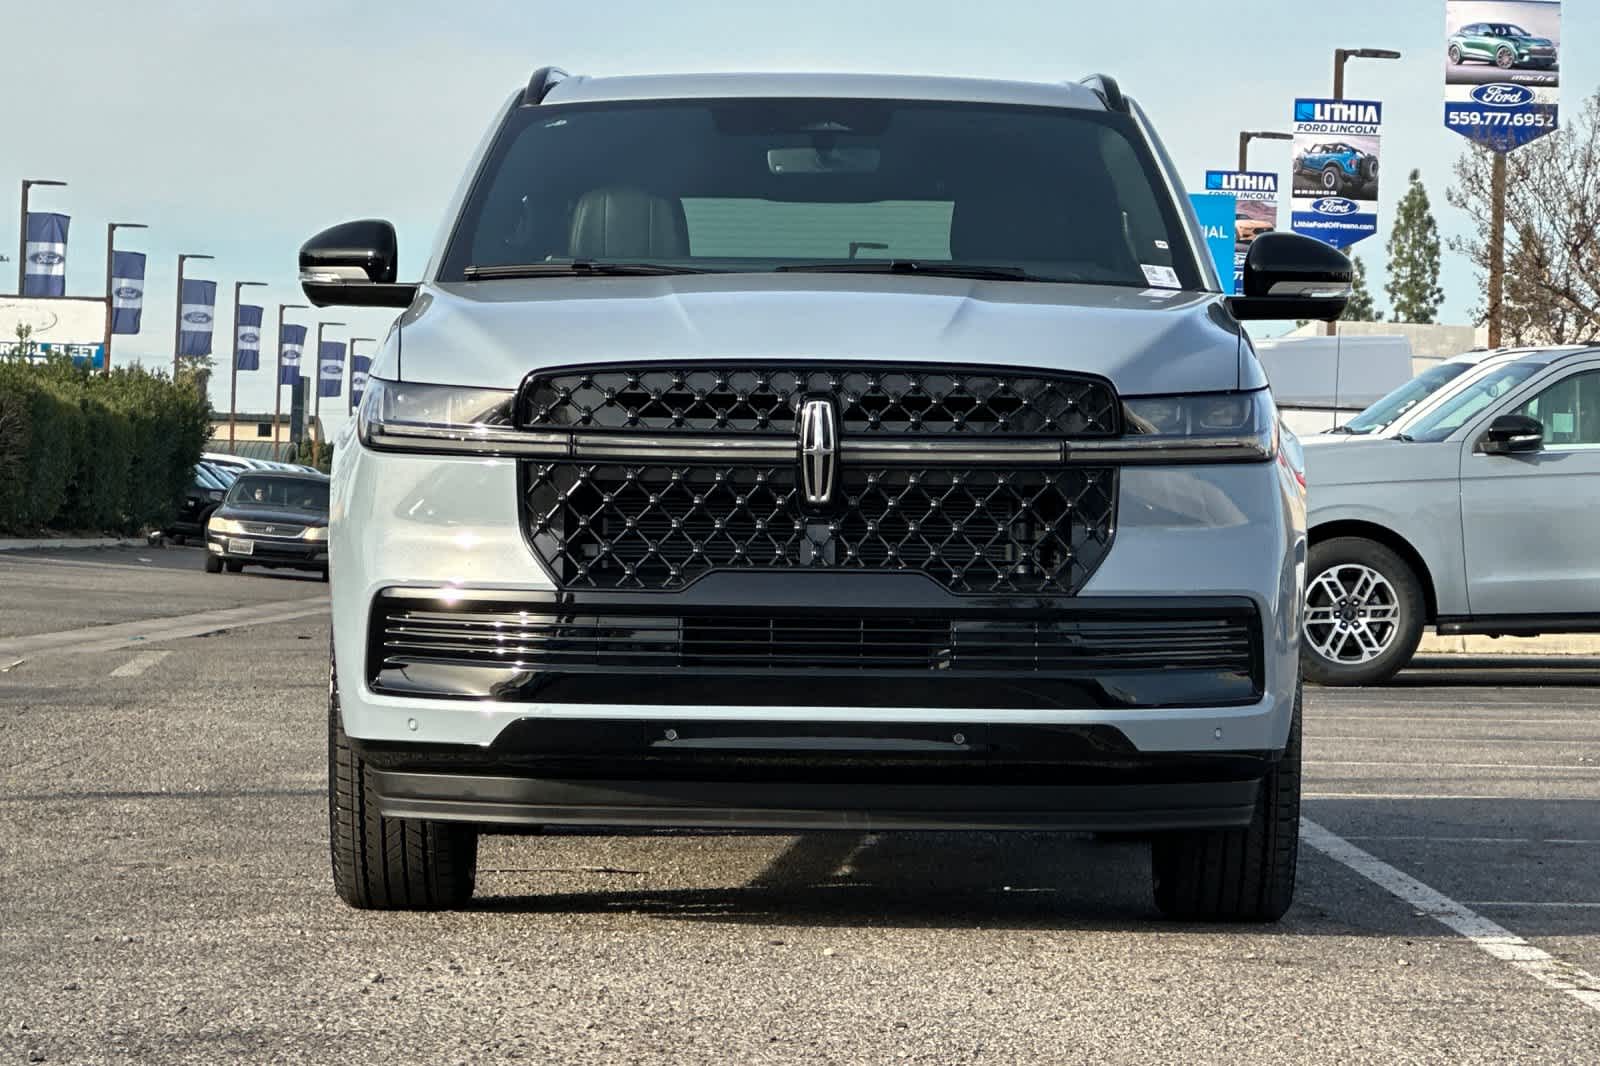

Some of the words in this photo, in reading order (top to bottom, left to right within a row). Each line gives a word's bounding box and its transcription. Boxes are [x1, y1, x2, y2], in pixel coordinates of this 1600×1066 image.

[1482, 85, 1522, 103] Ford
[1315, 103, 1379, 122] LITHIA
[1449, 111, 1554, 127] 559.777.6952
[1297, 123, 1328, 132] FORD
[1329, 124, 1378, 134] LINCOLN
[1222, 174, 1276, 191] LITHIA
[1319, 199, 1351, 213] Ford
[1201, 224, 1229, 239] IAL
